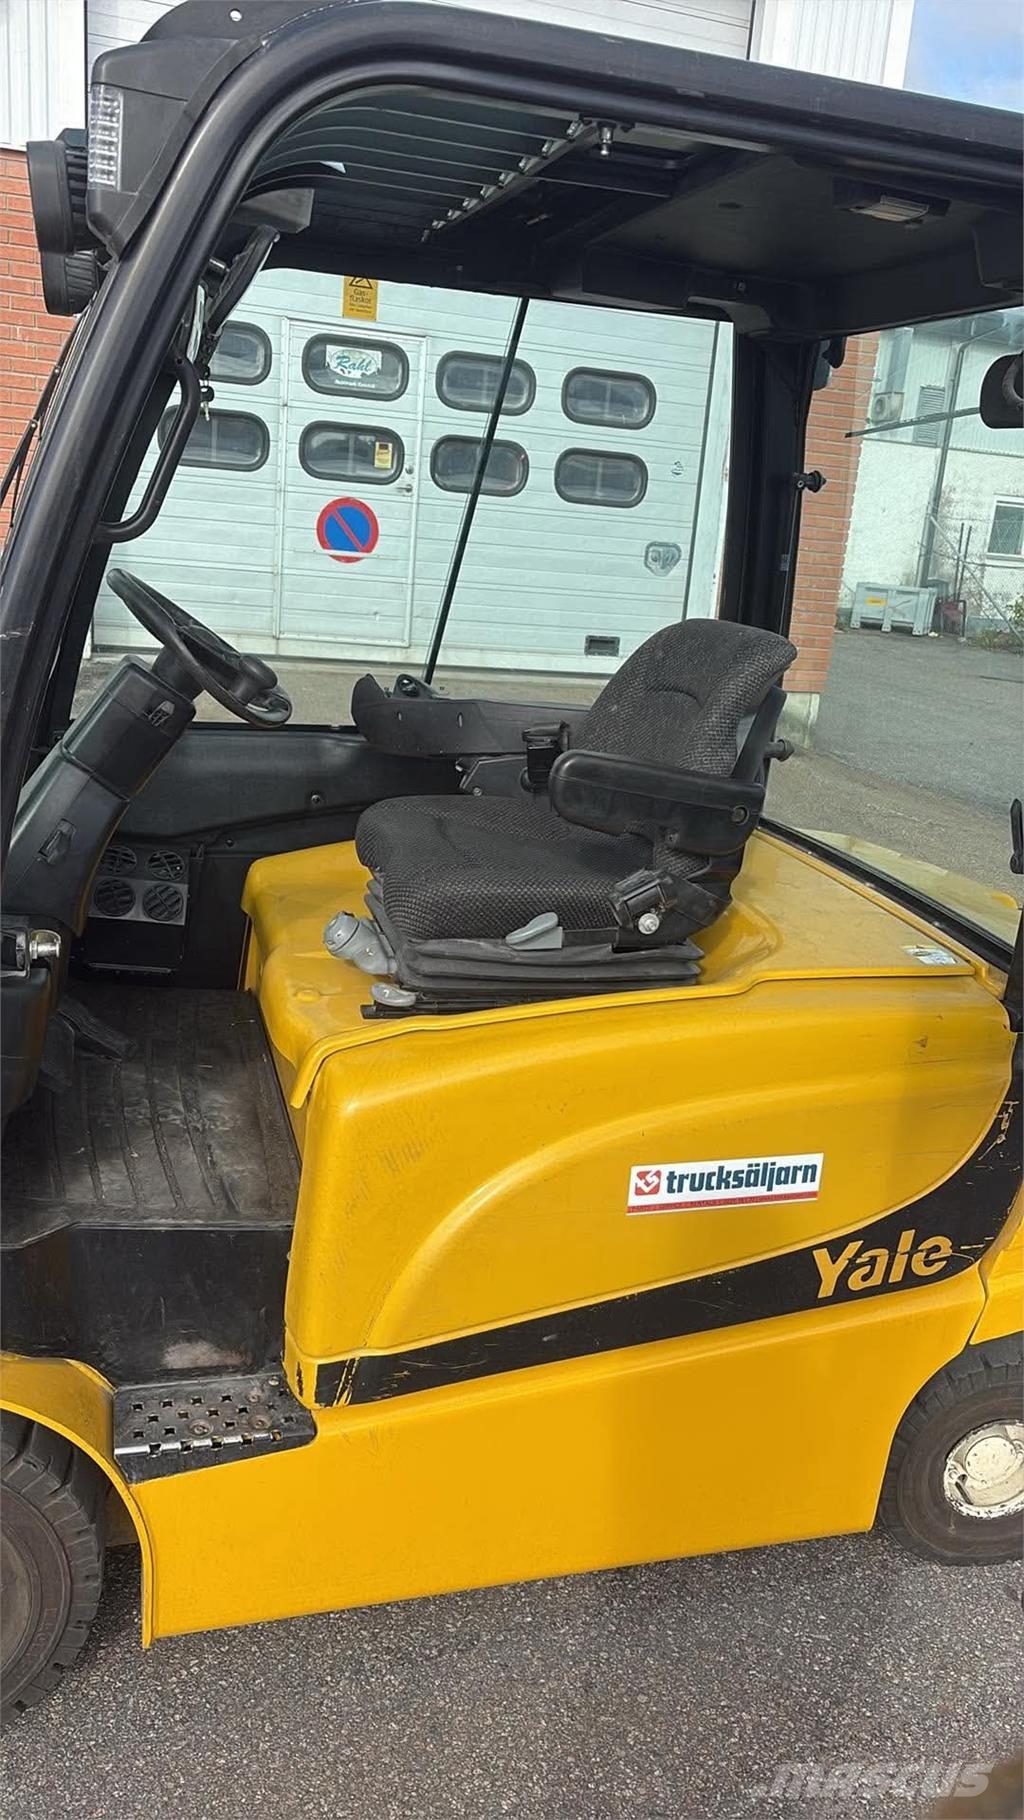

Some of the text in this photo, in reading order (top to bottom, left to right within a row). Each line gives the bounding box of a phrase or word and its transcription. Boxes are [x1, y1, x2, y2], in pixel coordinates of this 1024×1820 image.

[335, 355, 372, 372] Rahl
[666, 1161, 818, 1195] trucksäljarn
[812, 1229, 953, 1299] Yale
